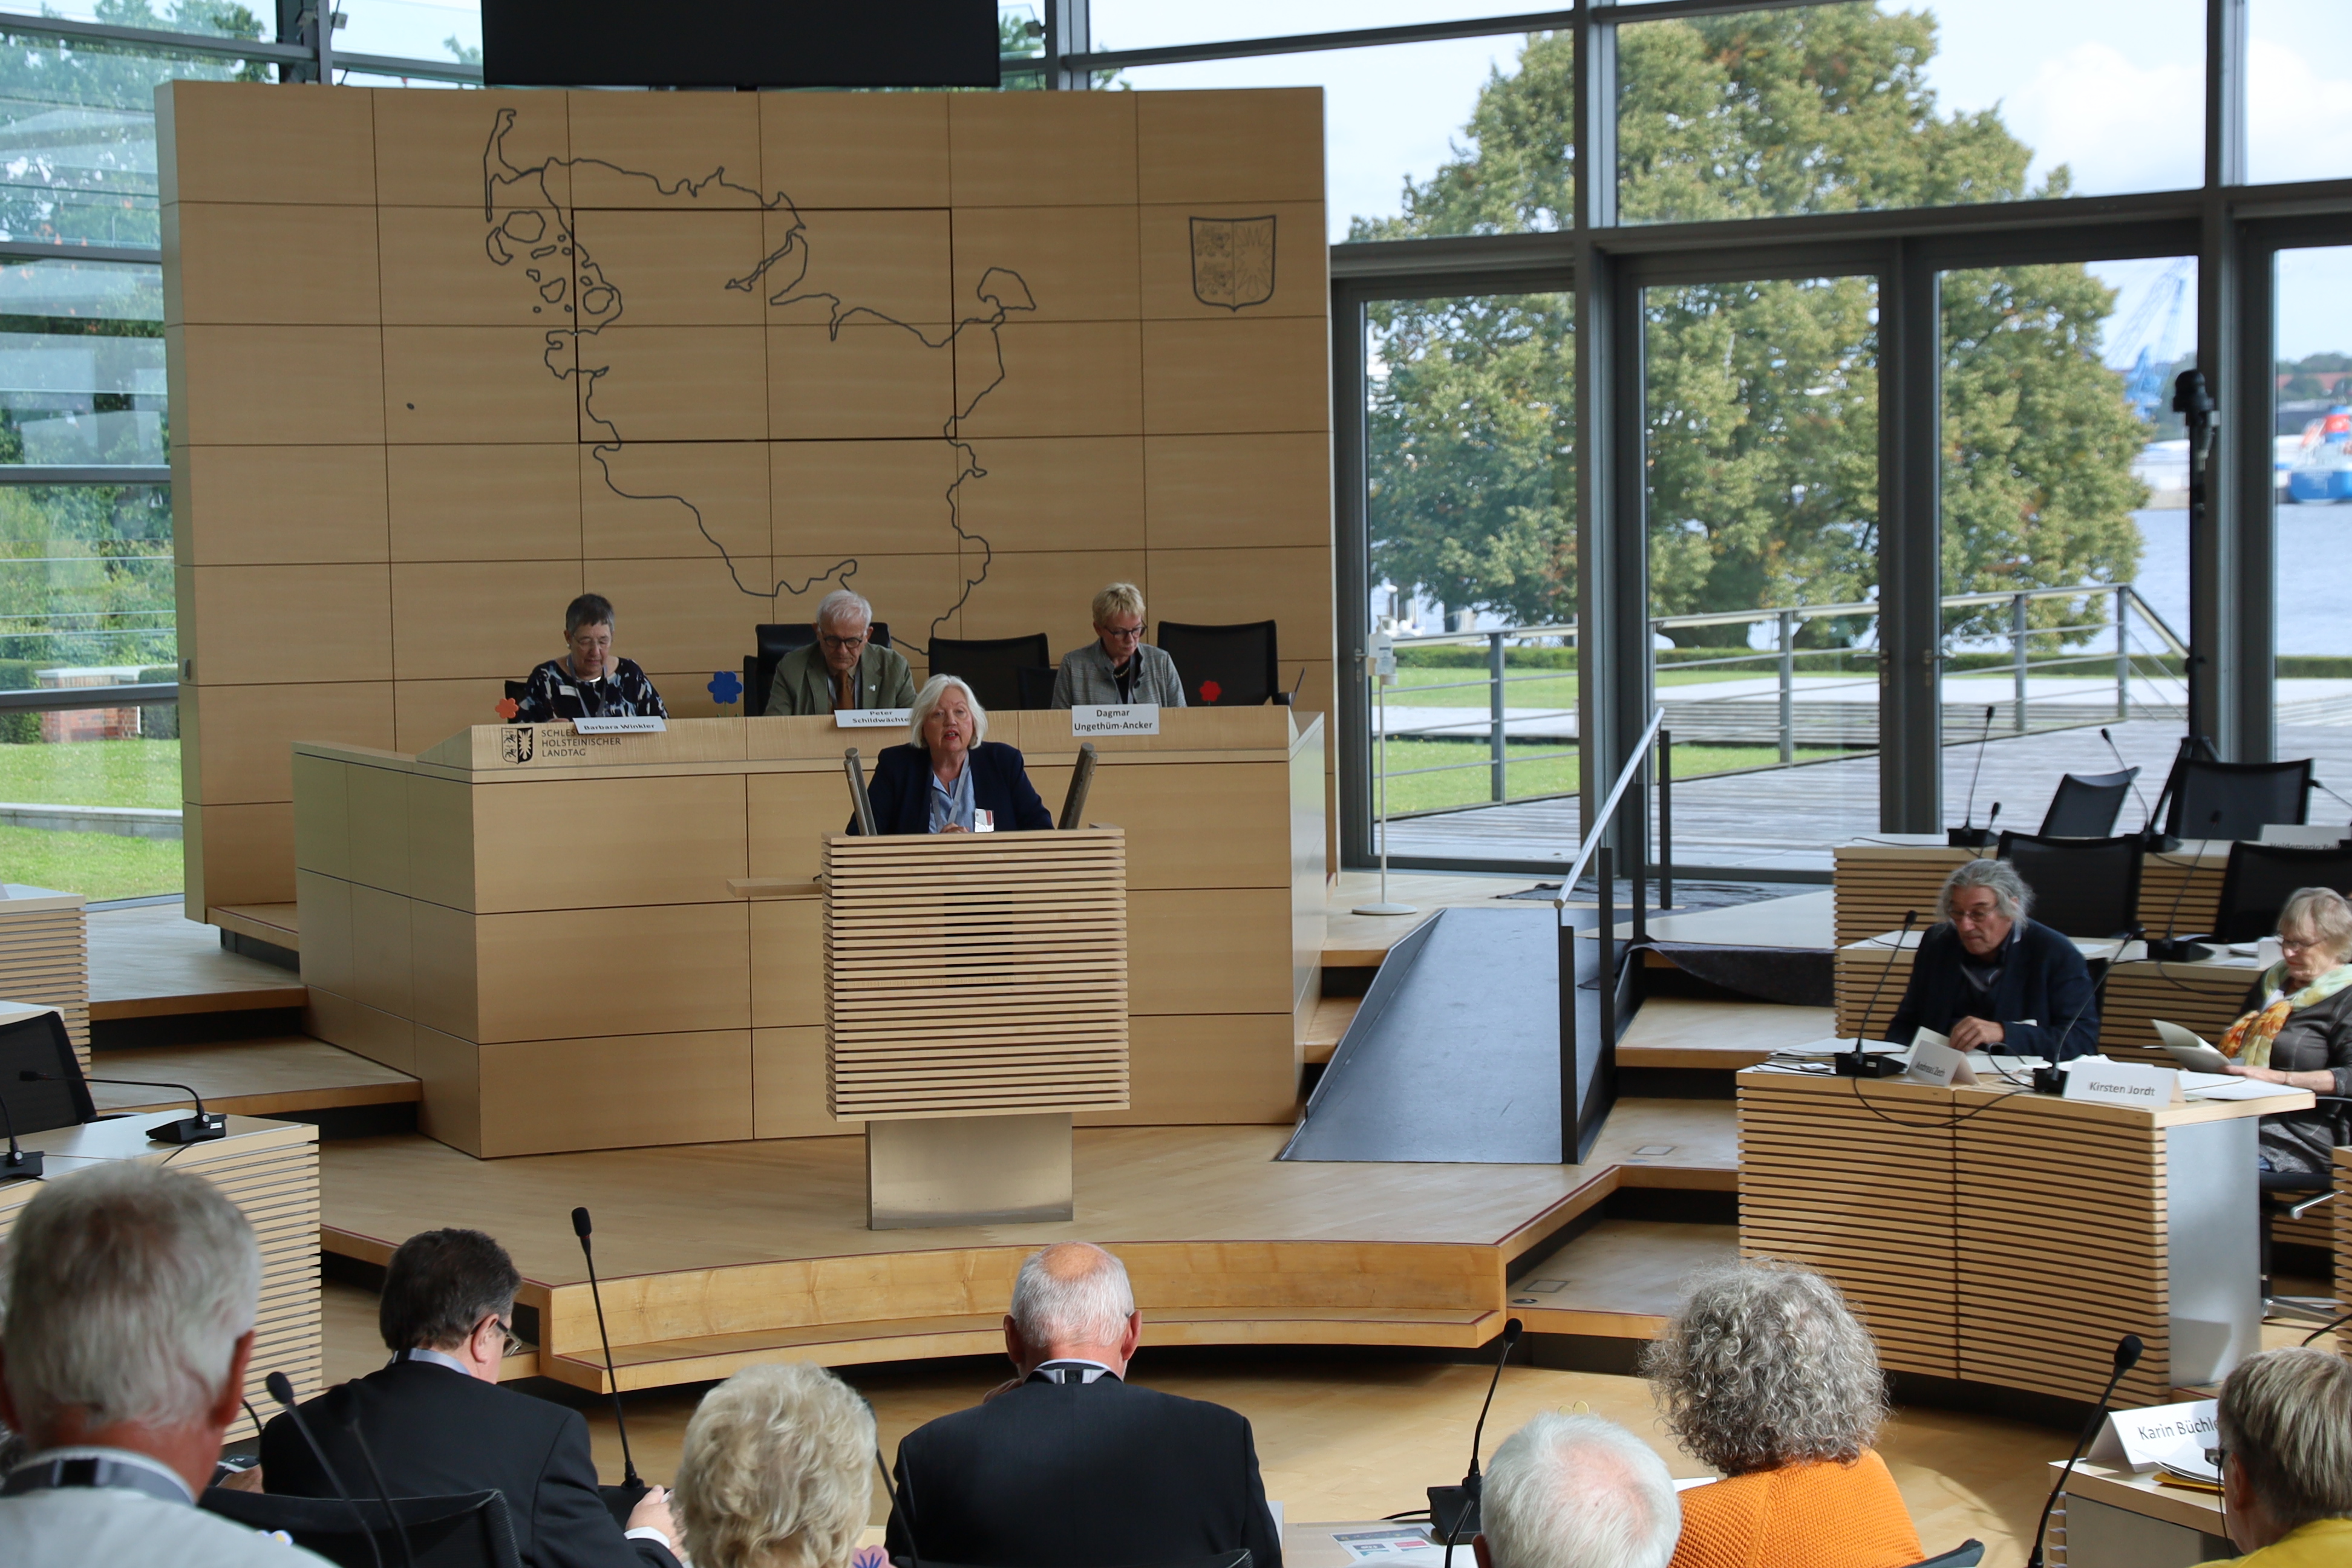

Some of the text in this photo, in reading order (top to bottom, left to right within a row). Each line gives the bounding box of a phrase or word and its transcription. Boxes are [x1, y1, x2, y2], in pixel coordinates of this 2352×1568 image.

[1096, 710, 1130, 718] Dagmar
[1074, 721, 1152, 732] Ungethüm-Ancker
[541, 737, 621, 747] HOLSTEINISCHER
[542, 748, 586, 757] LANDTAG
[2089, 1082, 2155, 1096] Kirsten Jordt
[2137, 1423, 2175, 1440] Karin
